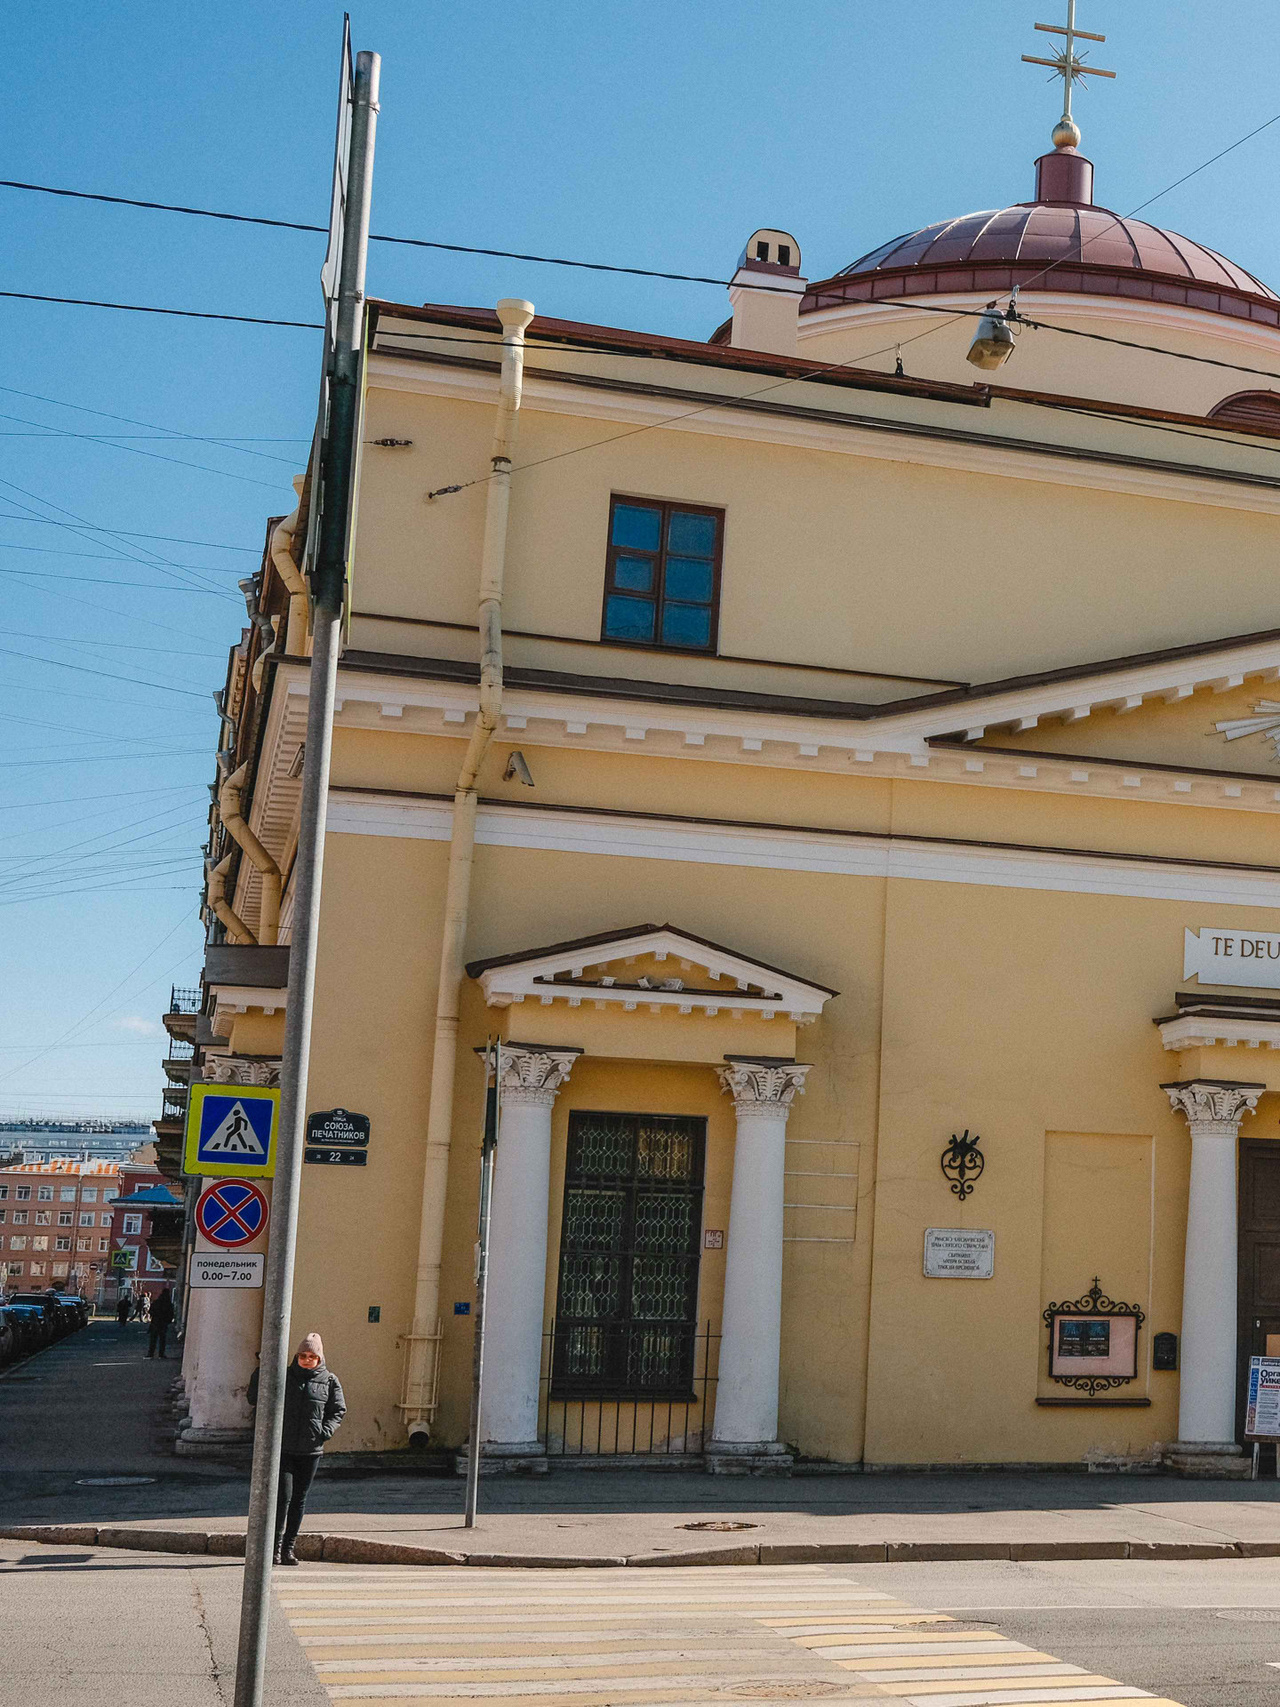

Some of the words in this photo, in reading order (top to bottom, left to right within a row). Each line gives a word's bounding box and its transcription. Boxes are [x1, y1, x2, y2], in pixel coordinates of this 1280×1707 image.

[1211, 936, 1233, 957] TE
[324, 1121, 354, 1131] СОЮЗА
[311, 1129, 365, 1140] ПЕЧАТНИКОВ
[329, 1151, 342, 1162] 22
[197, 1261, 258, 1269] понедельник
